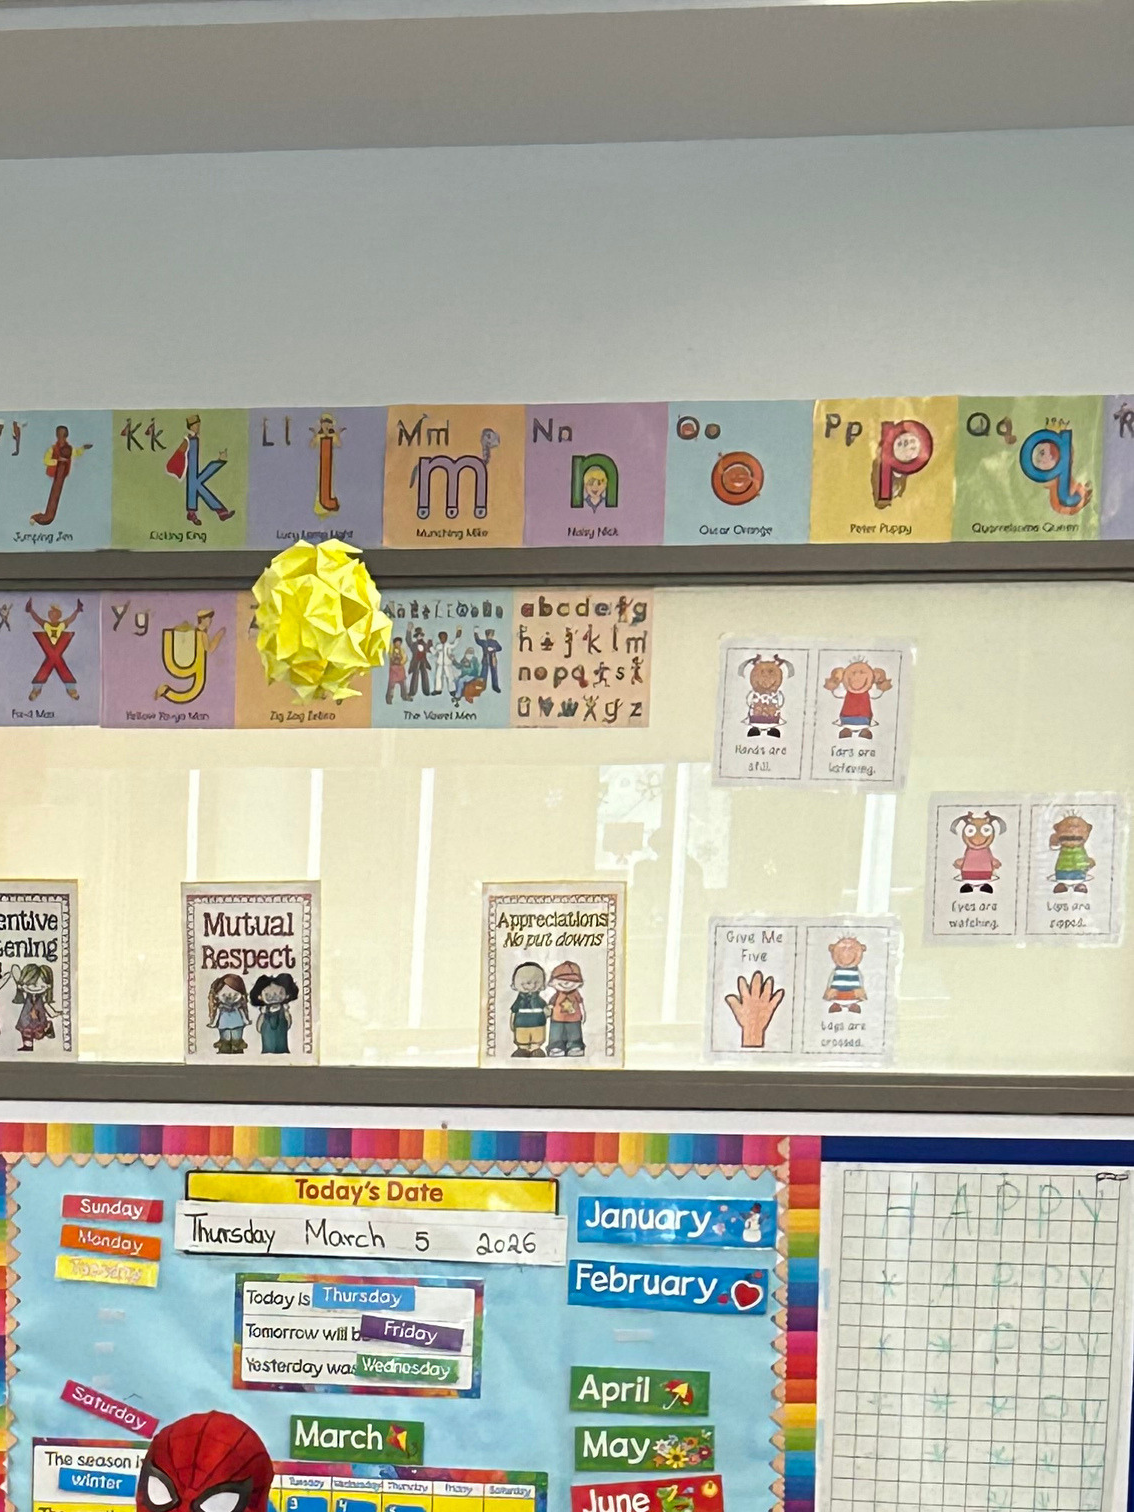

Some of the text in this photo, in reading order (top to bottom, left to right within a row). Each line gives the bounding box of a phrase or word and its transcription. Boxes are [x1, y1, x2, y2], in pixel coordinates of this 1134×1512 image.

[185, 435, 228, 513] k
[880, 418, 934, 501] p
[1019, 427, 1083, 508] q
[417, 454, 489, 519] m
[571, 452, 619, 509] n
[31, 631, 76, 685] x
[161, 627, 208, 704] y
[203, 912, 295, 937] Mutual
[496, 911, 609, 931] Appreciations
[503, 932, 605, 950] No put downs
[726, 930, 783, 944] Give Me
[201, 944, 296, 975] Respect
[740, 949, 768, 962] Five
[294, 1178, 443, 1206] Today's Date
[79, 1198, 144, 1220] Sunday
[585, 1200, 713, 1239] January
[78, 1229, 144, 1256] Monday
[184, 1212, 537, 1256] Thursday March 5 2026
[246, 1289, 295, 1306] Today
[322, 1286, 403, 1308] Thursday
[575, 1263, 718, 1305] February
[245, 1323, 320, 1341] Tomorrow
[323, 1326, 348, 1342] will
[383, 1320, 439, 1345] Friday
[245, 1356, 324, 1378] Yesterday
[362, 1356, 451, 1381] Wednesday
[577, 1373, 651, 1409] April
[71, 1386, 148, 1431] Saturday
[294, 1419, 384, 1451] March
[582, 1430, 651, 1465] May
[44, 1451, 73, 1466] The
[77, 1455, 132, 1469] season
[71, 1473, 124, 1490] winter
[289, 1497, 299, 1510] 3
[338, 1499, 348, 1512] 4
